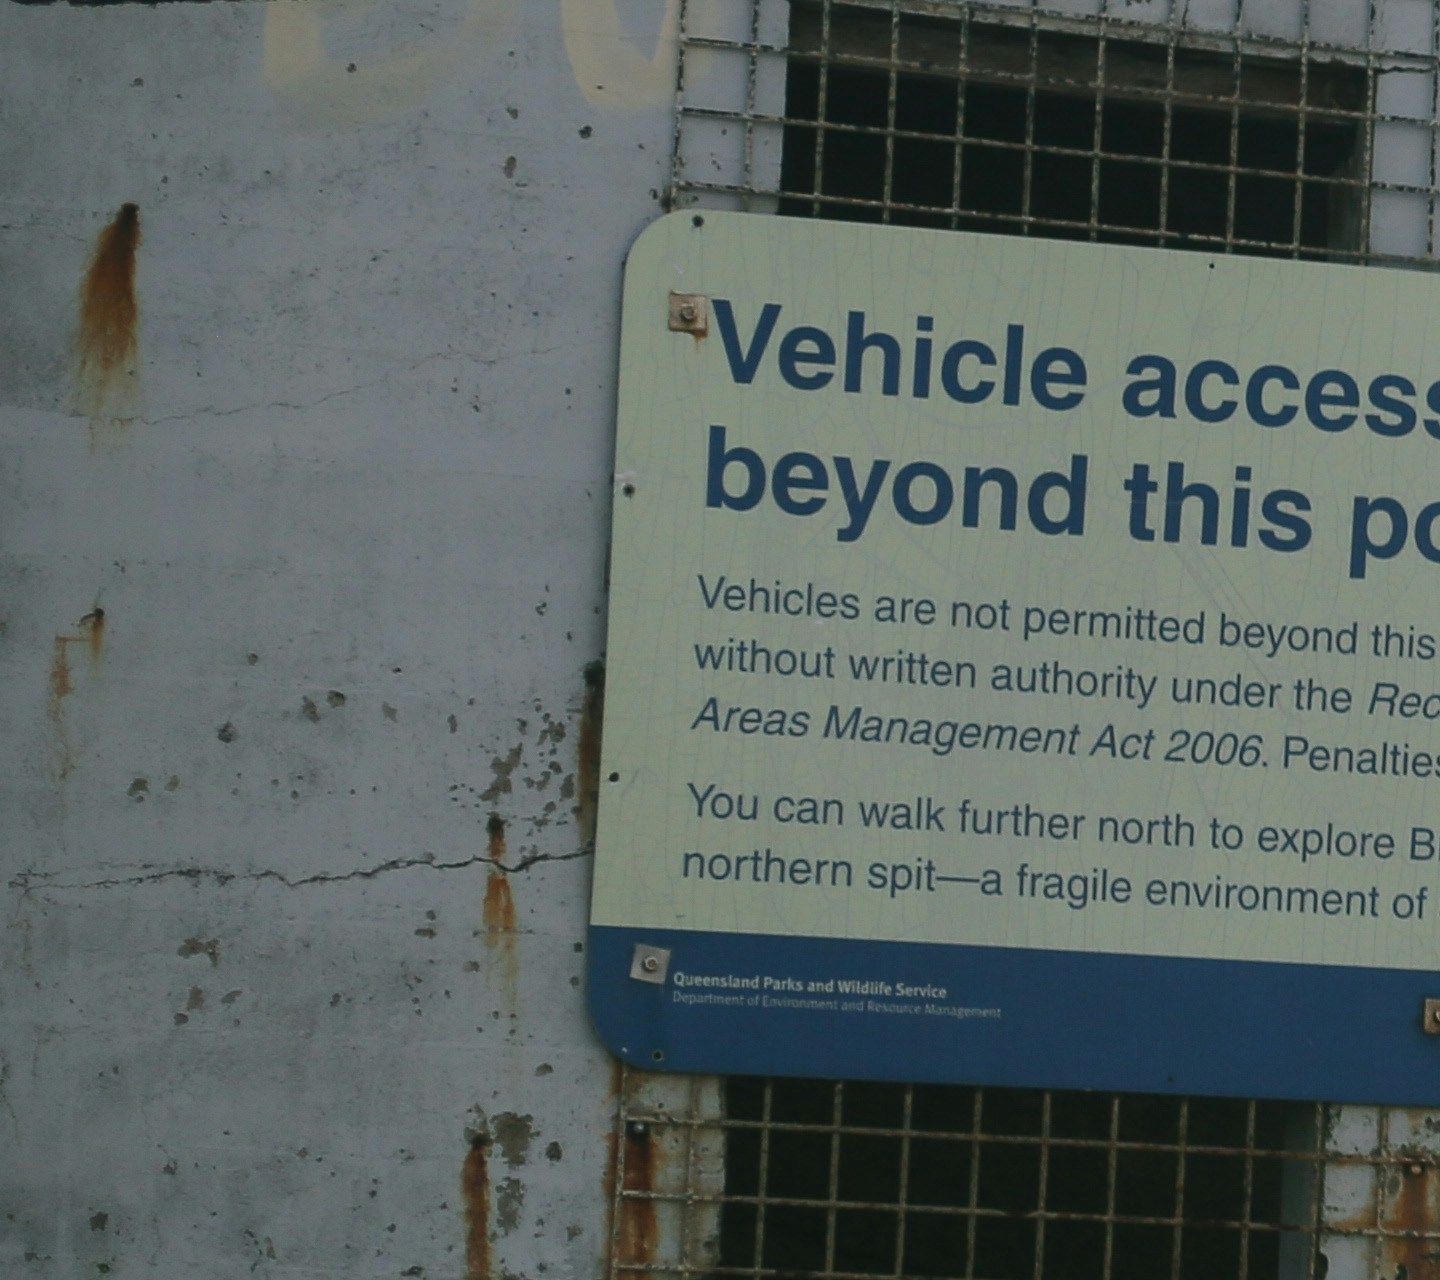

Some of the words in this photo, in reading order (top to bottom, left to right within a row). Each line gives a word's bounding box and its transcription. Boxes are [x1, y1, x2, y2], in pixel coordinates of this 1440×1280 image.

[712, 298, 1087, 410] Vehicle
[705, 425, 1088, 543] beyond
[1124, 461, 1312, 553] this
[698, 575, 860, 619] Vehicles
[874, 596, 936, 626] are
[951, 599, 1011, 630] not
[1023, 606, 1205, 644] permitted
[1219, 613, 1358, 657] beyond
[1371, 624, 1435, 660] this
[694, 638, 835, 679] without
[850, 650, 976, 688] written
[991, 661, 1158, 708] authority
[1171, 674, 1282, 710] under
[1294, 678, 1352, 714] the
[691, 697, 810, 737] Areas
[823, 705, 1080, 756] Management
[1090, 723, 1156, 761] Act
[1164, 729, 1267, 768] 2006.
[687, 783, 758, 820] You
[774, 795, 844, 825] can
[860, 797, 945, 832] walk
[958, 800, 1085, 839] further
[1098, 814, 1194, 847] north
[1209, 819, 1243, 849] to
[1258, 823, 1395, 861] explore
[682, 849, 852, 887] northern
[1017, 863, 1132, 909] fragile
[1145, 876, 1379, 918] environment
[1392, 887, 1427, 919] of
[673, 972, 759, 990] Queensland
[764, 977, 801, 992] Parks
[807, 980, 833, 993] and
[838, 980, 891, 996] Wildlife
[895, 983, 947, 999] Service
